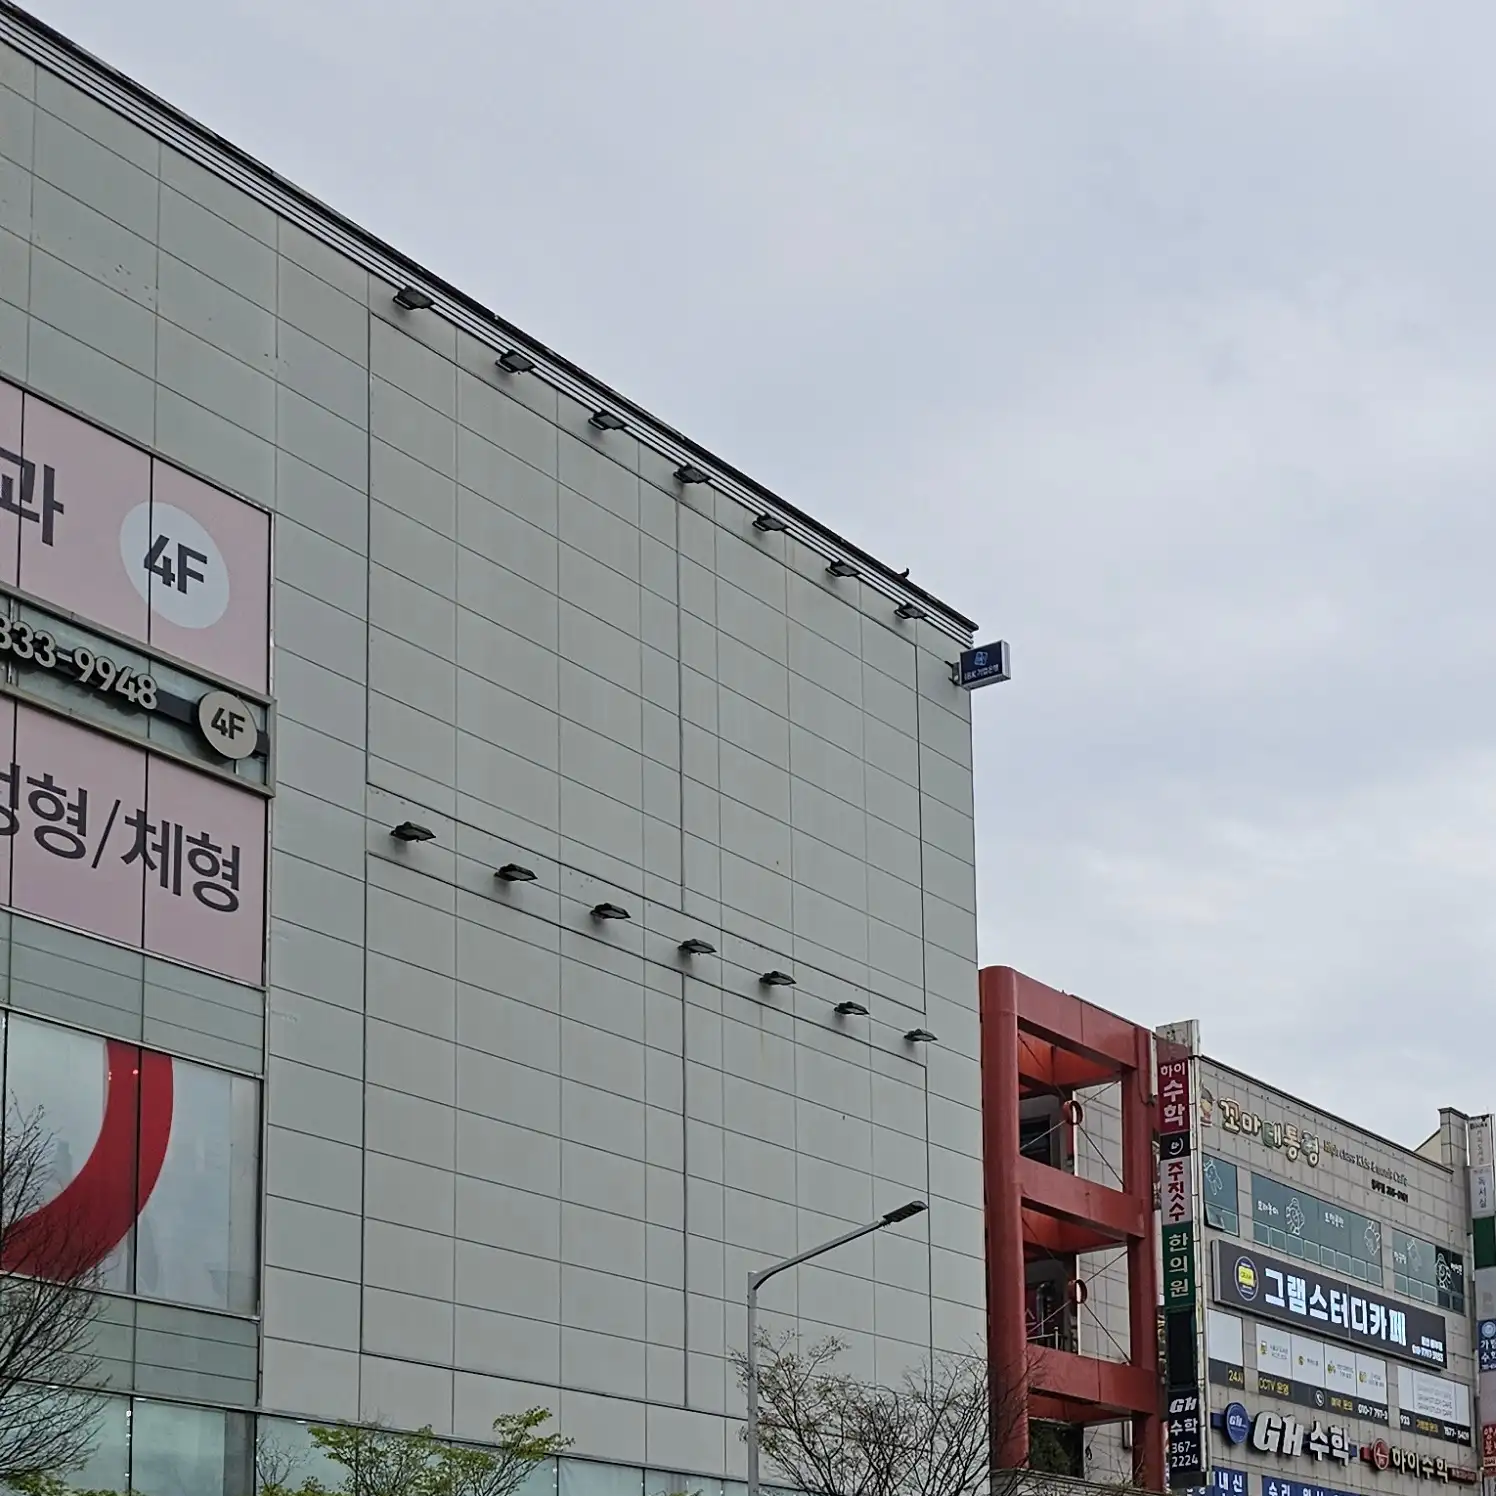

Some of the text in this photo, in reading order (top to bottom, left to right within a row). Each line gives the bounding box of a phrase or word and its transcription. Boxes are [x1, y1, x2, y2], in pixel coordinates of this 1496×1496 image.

[144, 534, 207, 594] 4F
[211, 706, 245, 740] 4F
[1160, 1062, 1185, 1078] 하이
[1163, 1079, 1185, 1127] 수학
[1167, 1160, 1185, 1222] 주짓수
[1169, 1233, 1189, 1299] 한의원
[1169, 1397, 1197, 1413] GH
[1170, 1418, 1198, 1436] 수학
[1253, 1411, 1350, 1467] GH 수학
[1172, 1454, 1198, 1468] 2224
[1392, 1447, 1449, 1483] 하이수학
